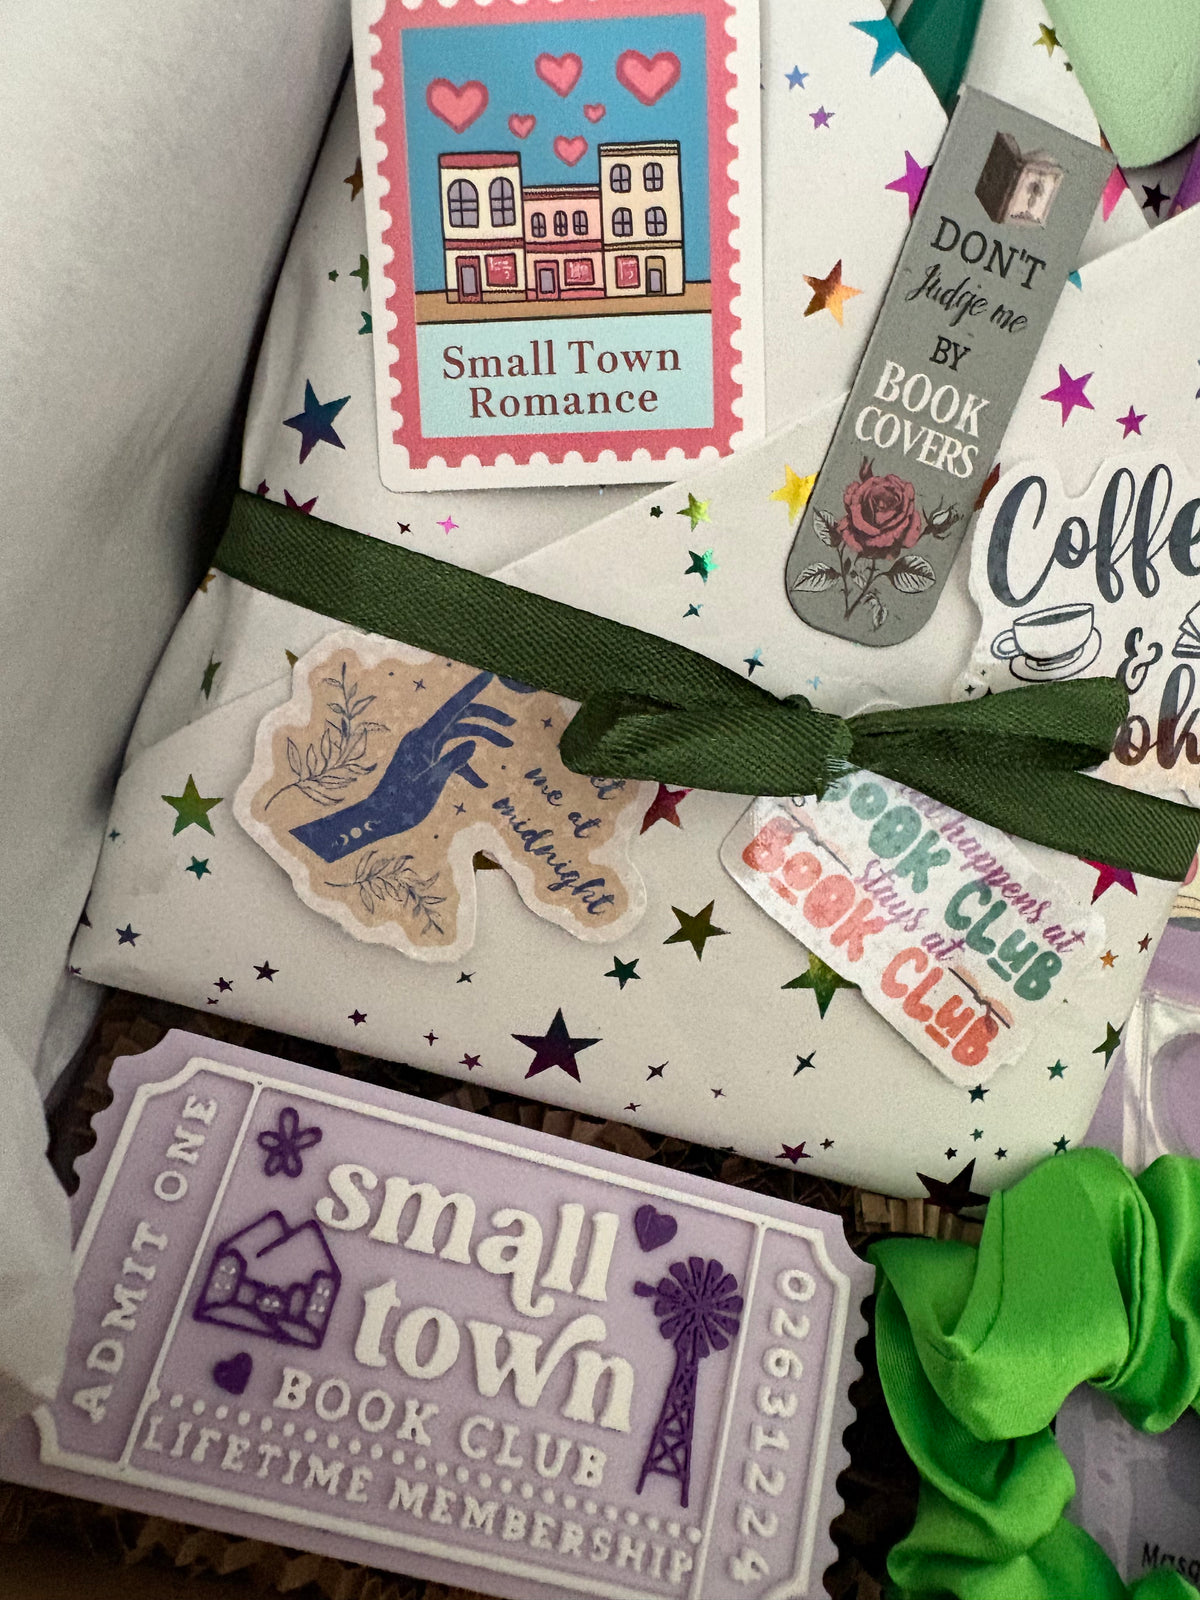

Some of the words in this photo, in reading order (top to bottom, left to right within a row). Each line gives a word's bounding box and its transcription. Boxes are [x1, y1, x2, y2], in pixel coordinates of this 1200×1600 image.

[930, 215, 1046, 290] DON'T
[443, 339, 557, 379] Small
[568, 340, 682, 374] Town
[929, 335, 971, 371] BY
[989, 304, 1028, 334] me
[469, 385, 659, 418] Romance
[855, 405, 979, 478] COVERS
[874, 360, 990, 438] BOOK
[1115, 627, 1163, 695] &
[524, 768, 563, 806] me
[568, 812, 601, 839] at
[821, 775, 951, 893] OOK
[492, 797, 615, 915] midnight
[939, 815, 1051, 924] happens
[1043, 924, 1086, 954] at
[854, 858, 929, 932] stays
[920, 932, 967, 961] at
[71, 1221, 168, 1424] ADMIT
[153, 1094, 219, 1202] ONE
[315, 1163, 620, 1318] small
[354, 1280, 635, 1432] town
[273, 1367, 440, 1446] BOOK
[458, 1415, 608, 1488] CLUB
[729, 1268, 817, 1585] 02631224
[143, 1415, 373, 1501] LIFETIME
[388, 1477, 694, 1584] MEMBERSHIP
